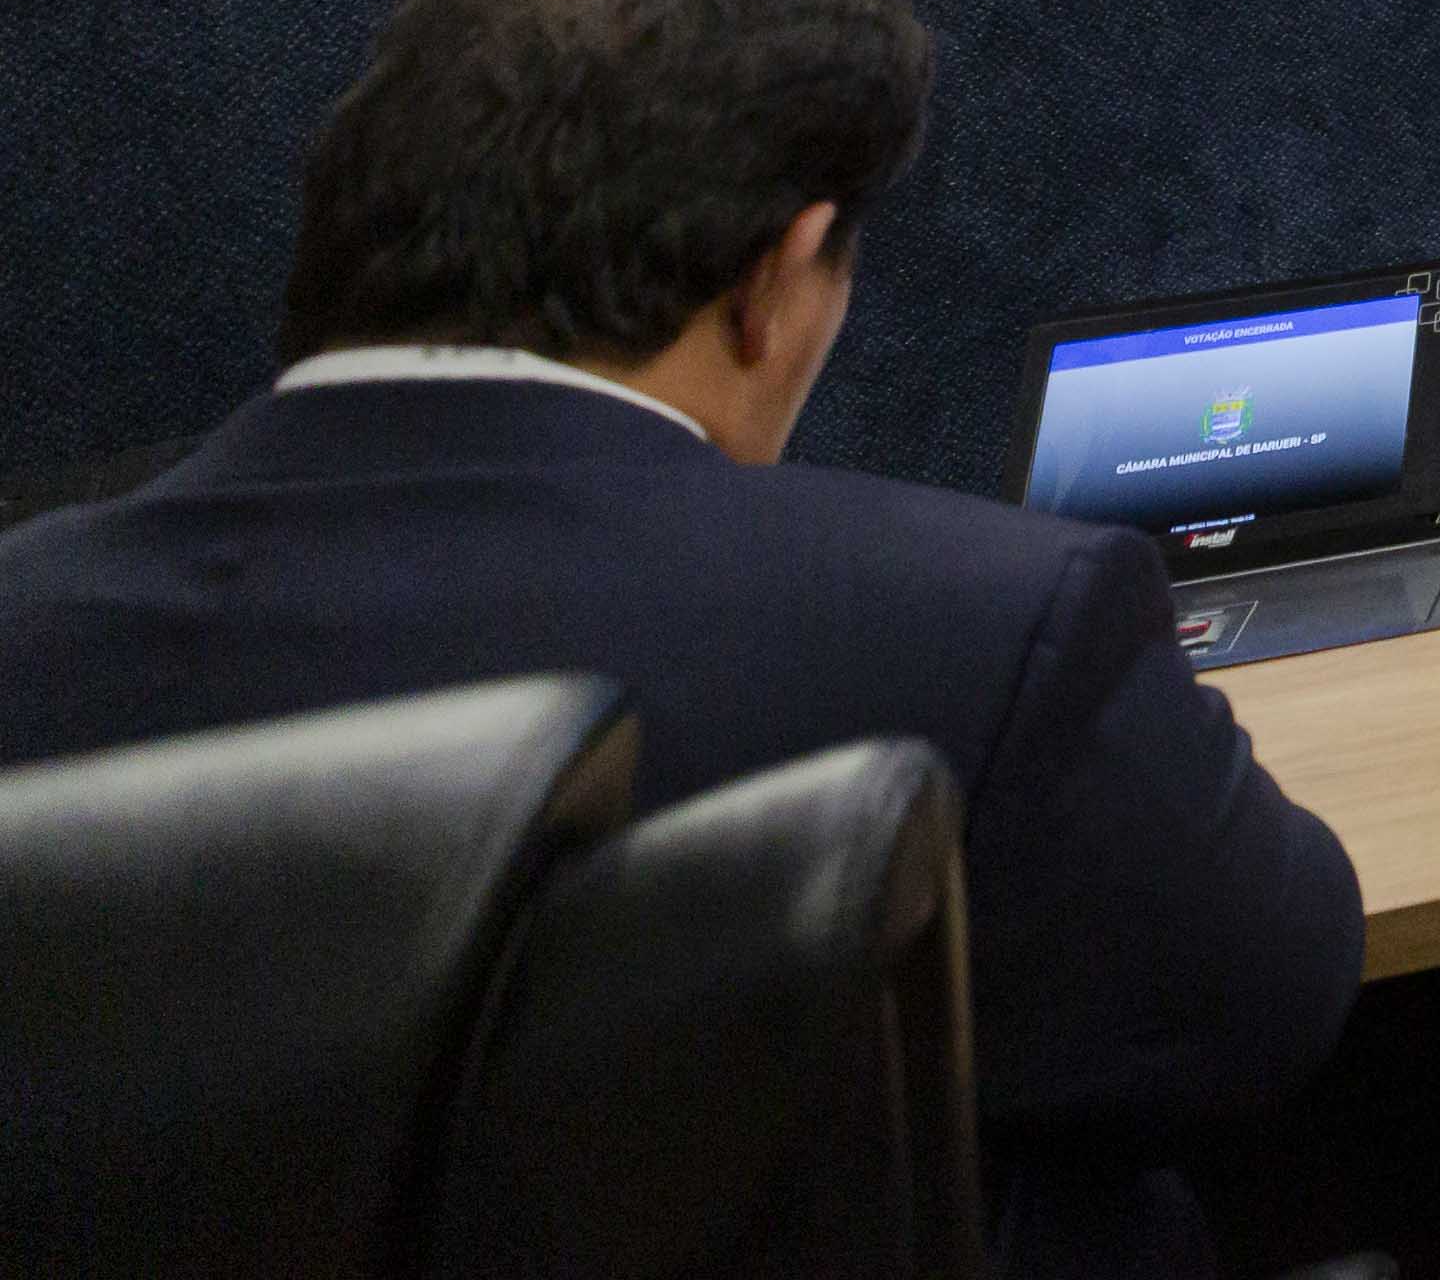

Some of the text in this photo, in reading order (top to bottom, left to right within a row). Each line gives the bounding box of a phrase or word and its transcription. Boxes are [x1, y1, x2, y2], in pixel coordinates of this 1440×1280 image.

[1184, 321, 1294, 345] VOTAÇÃO ENCERRADA
[1116, 432, 1327, 475] CÂMARA MUNICIPAL DE BARUERI SP
